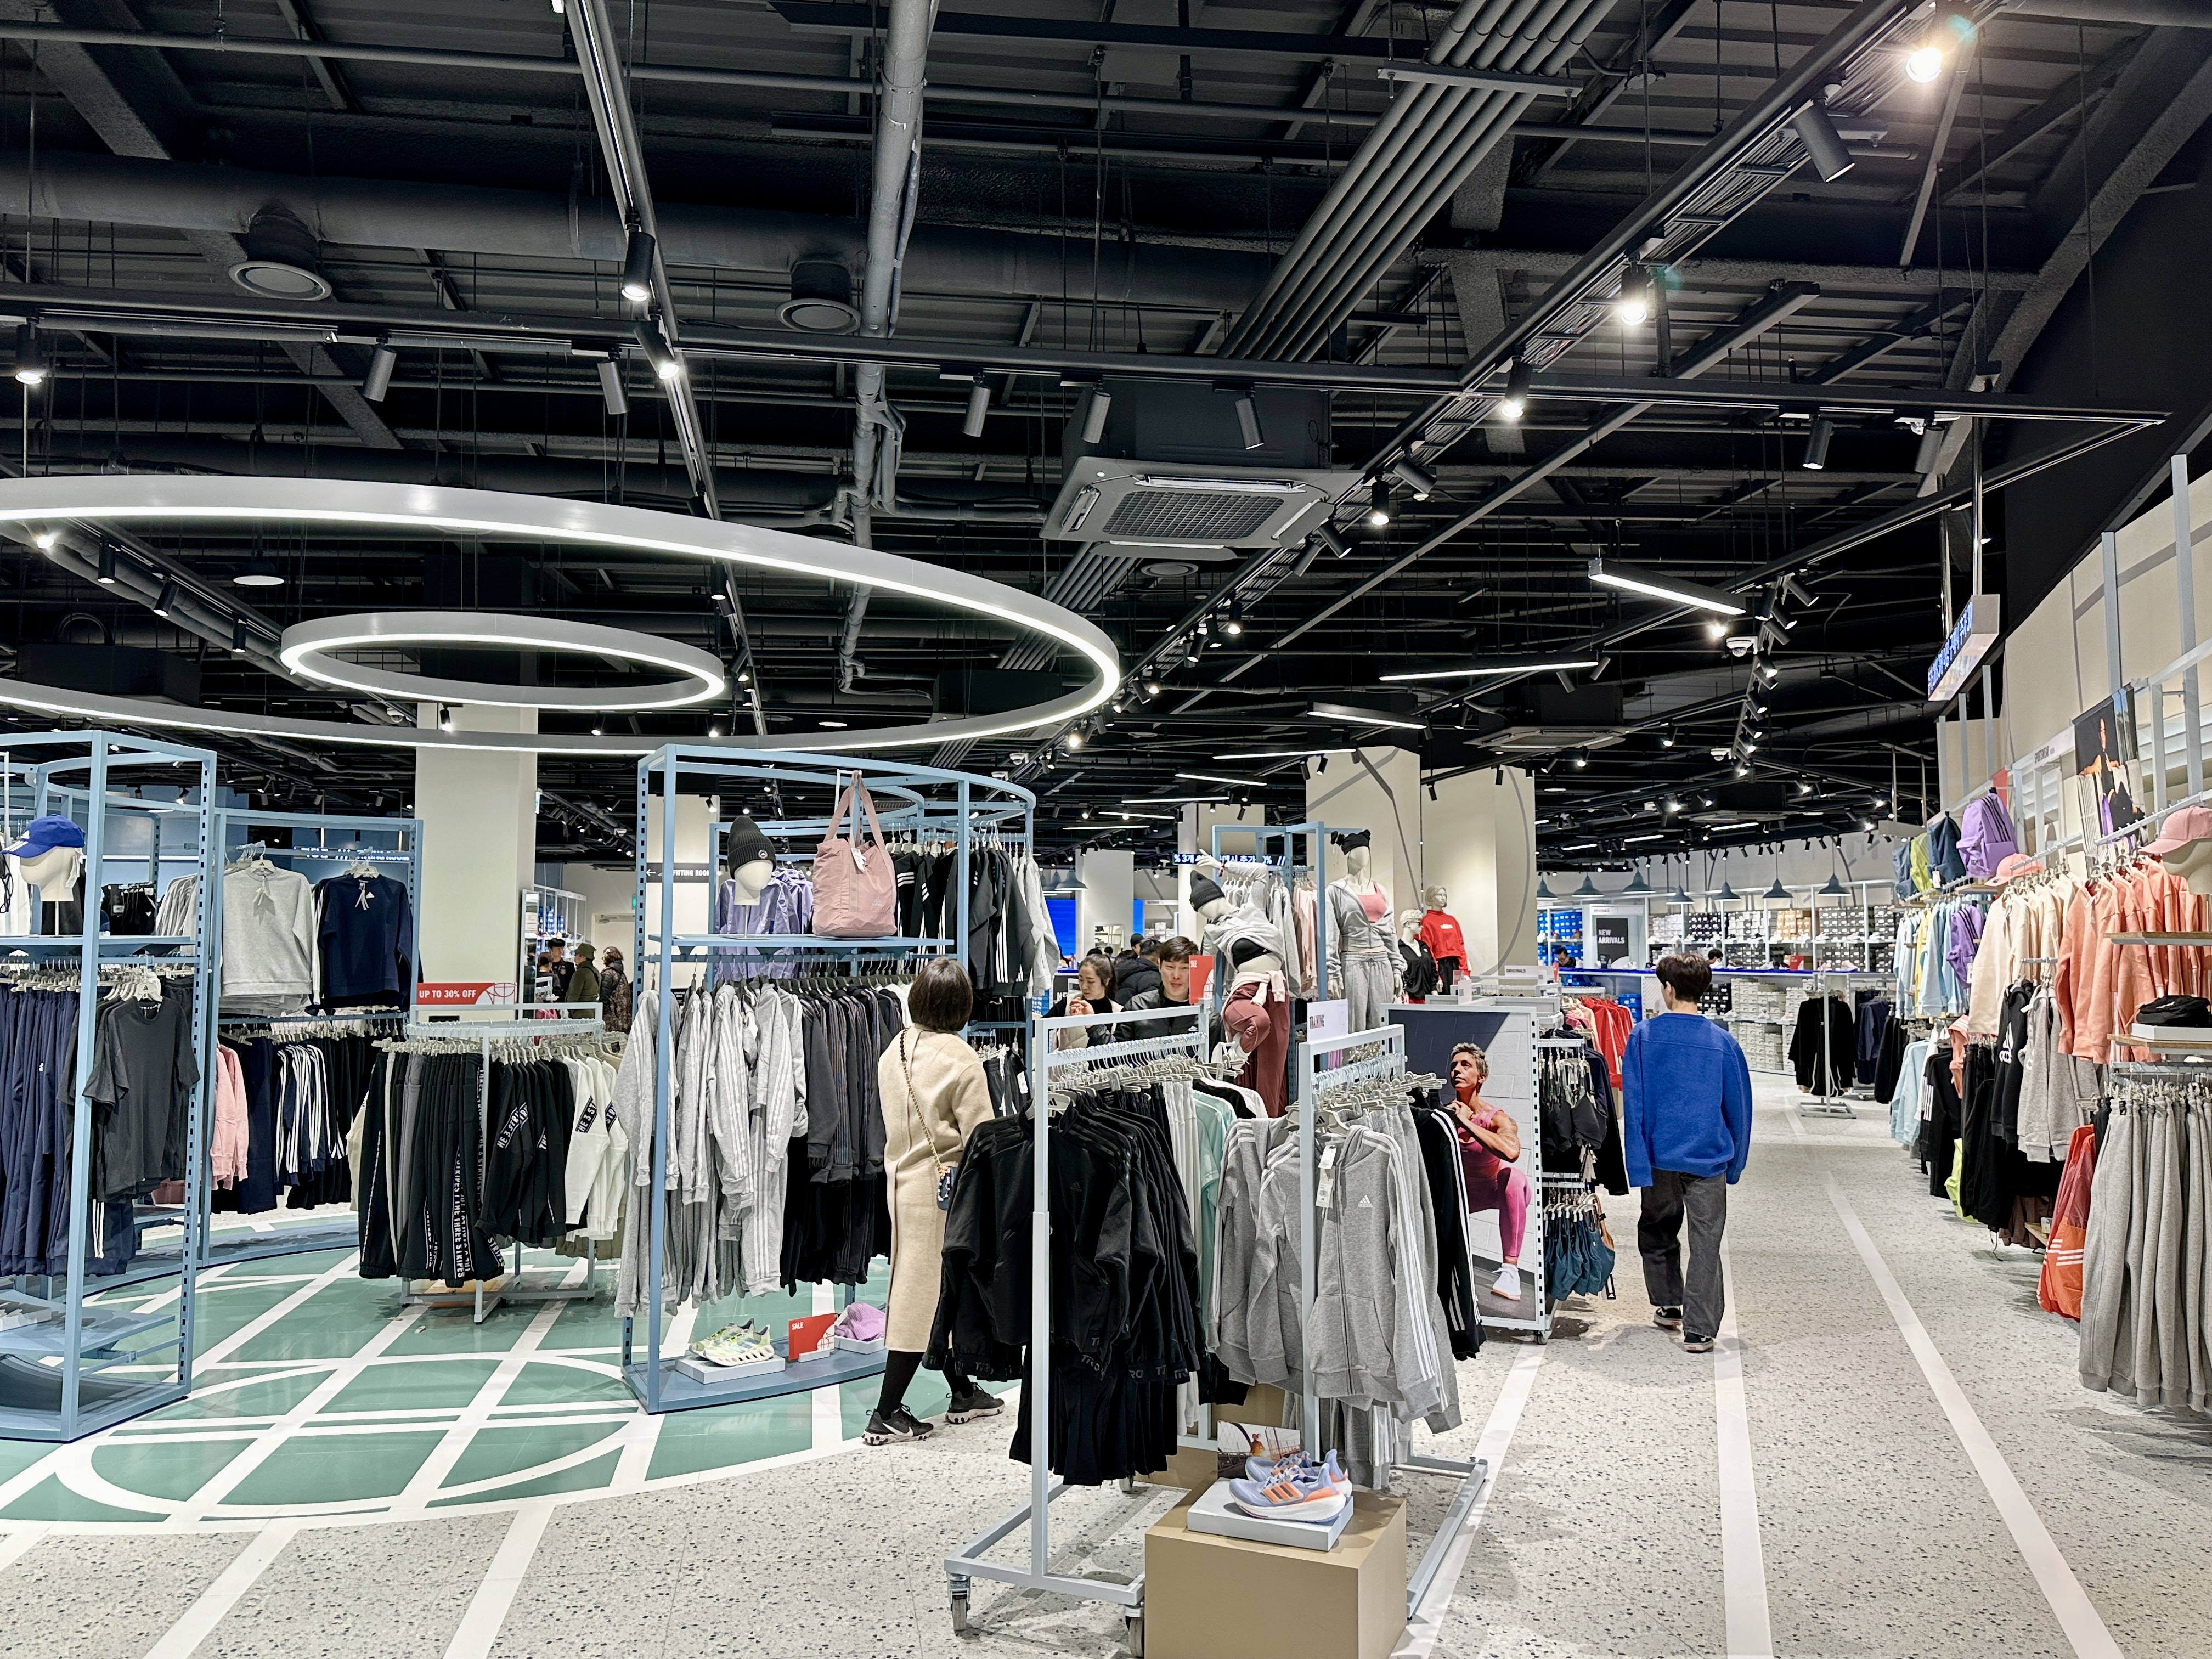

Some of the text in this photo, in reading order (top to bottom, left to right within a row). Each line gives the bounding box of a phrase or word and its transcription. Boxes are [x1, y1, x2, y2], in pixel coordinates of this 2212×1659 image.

[1220, 854, 1238, 862] 매시
[419, 990, 477, 998] UP TO 30% OFF
[1309, 1014, 1324, 1030] TRAINING
[588, 1101, 597, 1115] ST
[454, 1217, 462, 1243] THREE
[455, 1244, 466, 1278] STRIPES
[792, 1321, 804, 1330] SALE
